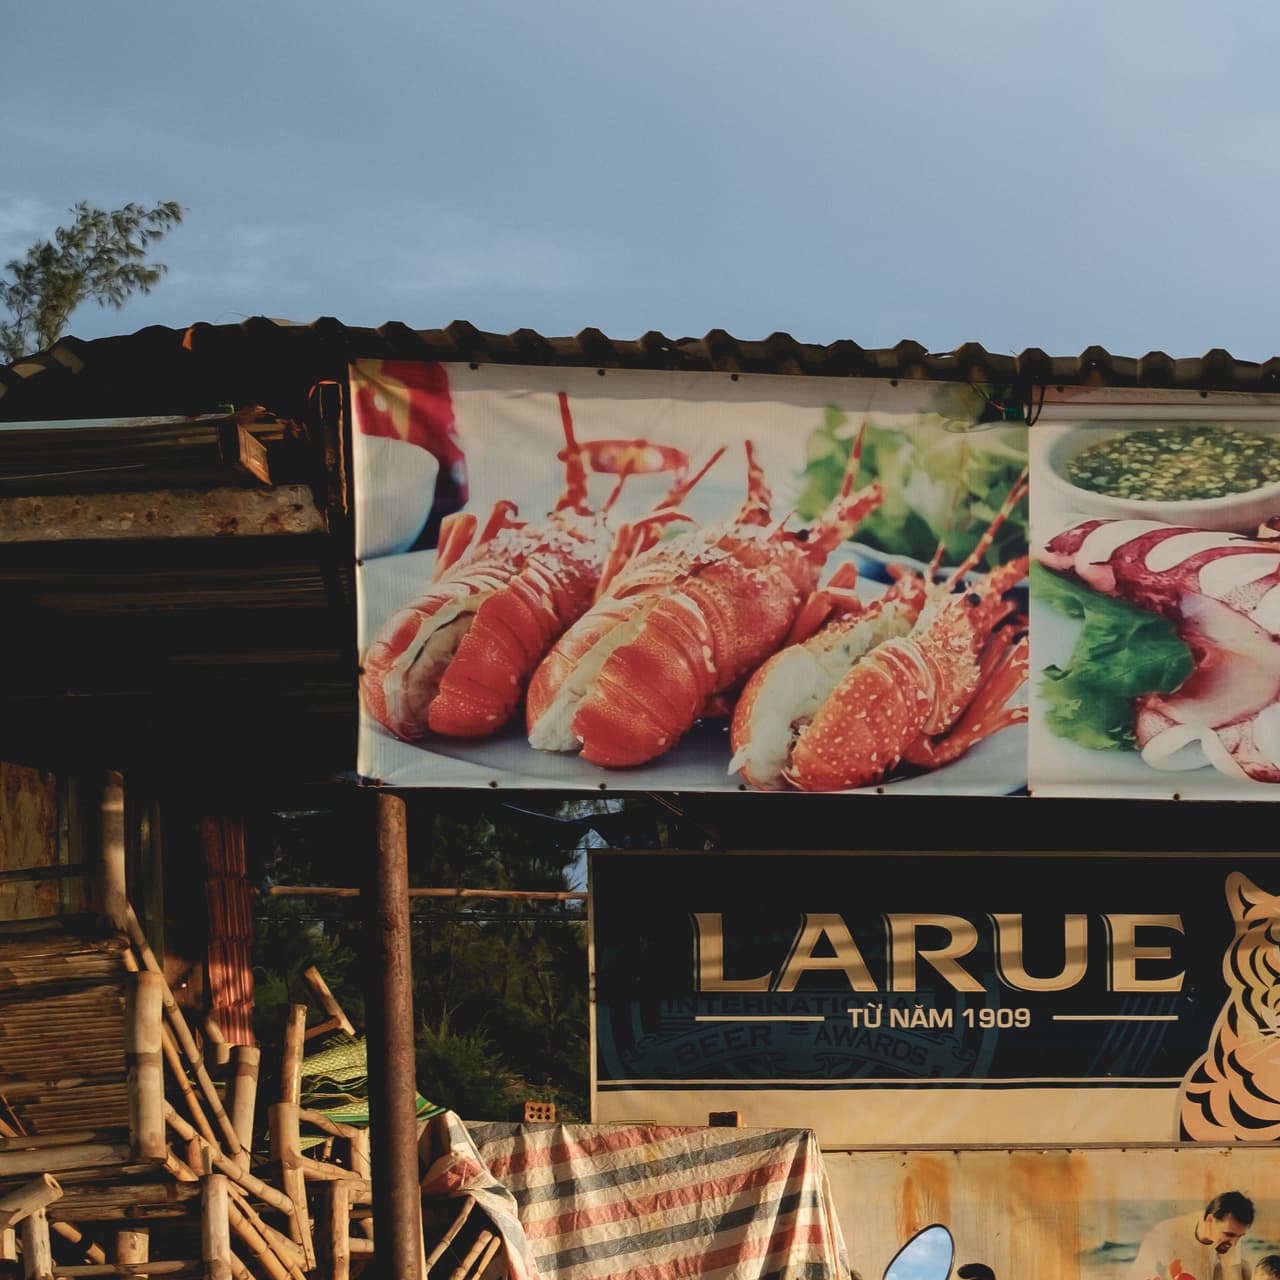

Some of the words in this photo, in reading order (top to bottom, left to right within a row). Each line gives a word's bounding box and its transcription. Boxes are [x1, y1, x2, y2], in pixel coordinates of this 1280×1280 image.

[690, 912, 1186, 993] LARUE
[847, 1002, 883, 1028] TỪ
[888, 1003, 953, 1028] NĂM
[961, 1007, 1031, 1029] 1909
[674, 1024, 772, 1066] BEER
[814, 1024, 929, 1067] AWARDS
